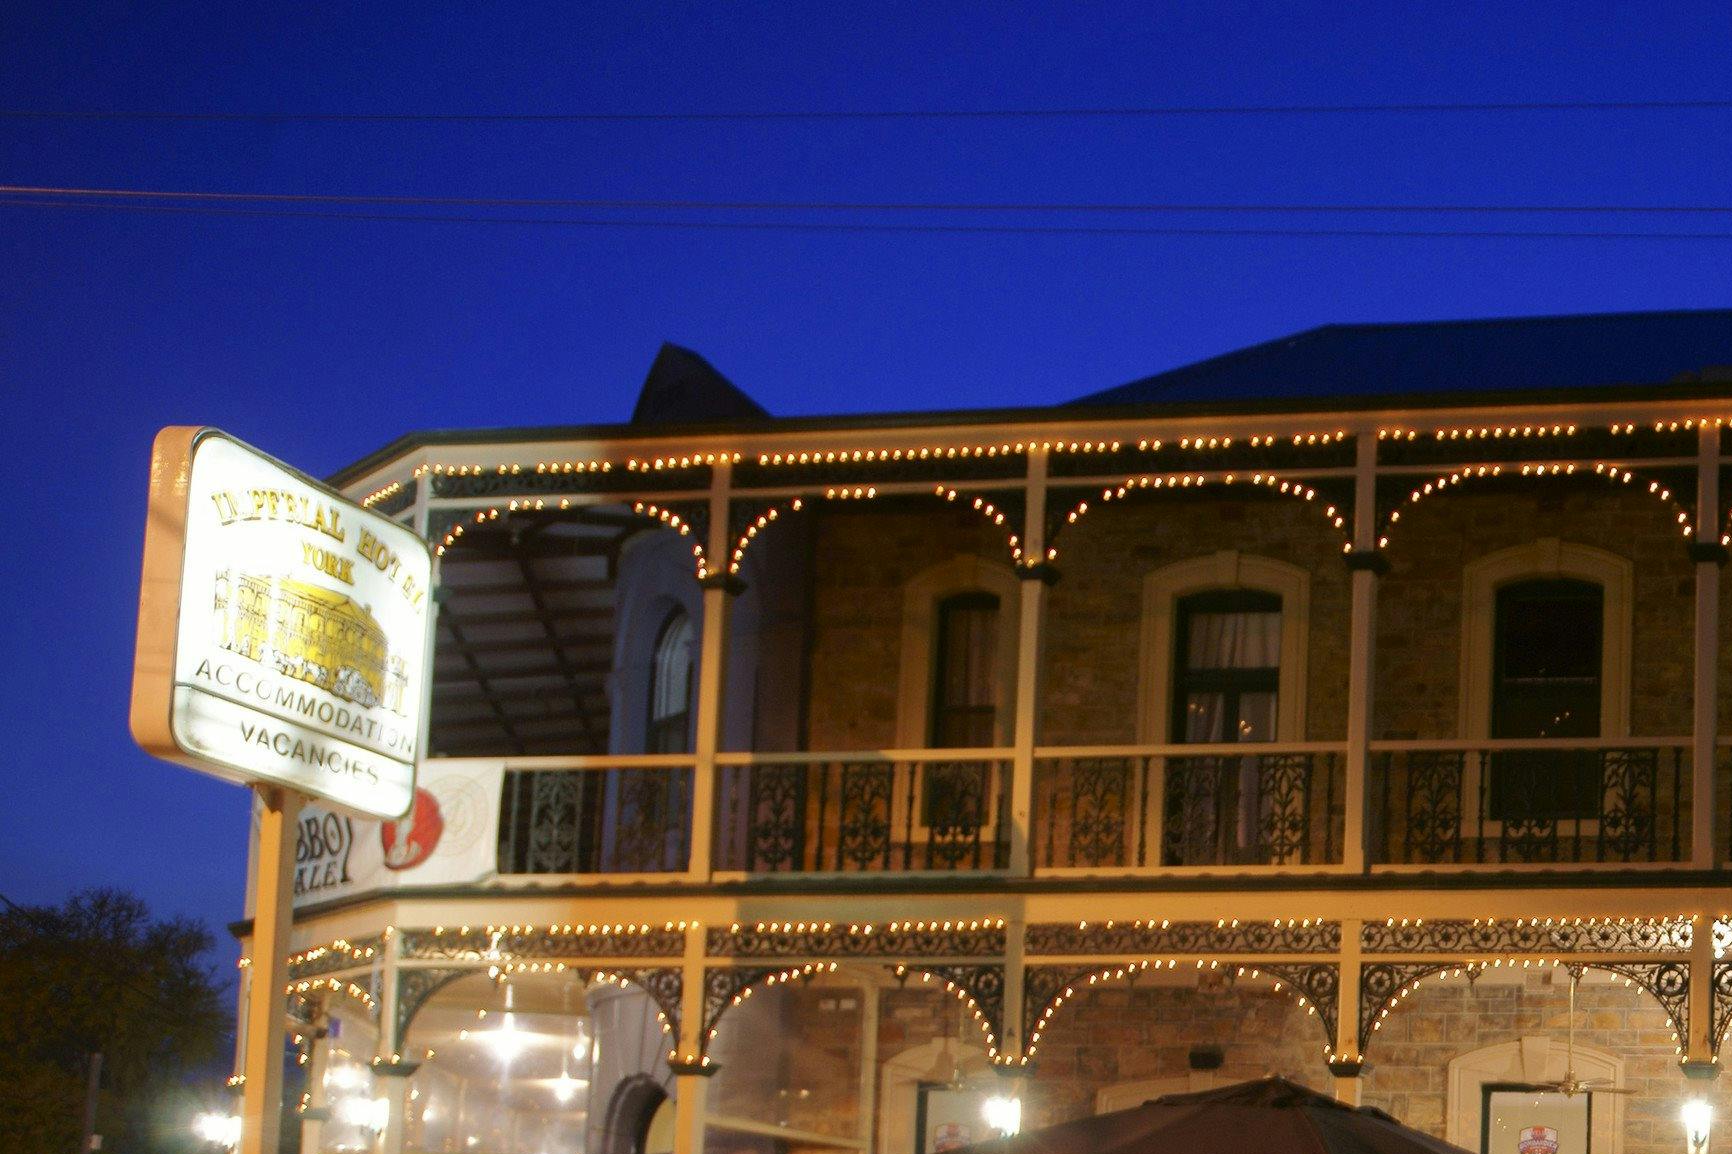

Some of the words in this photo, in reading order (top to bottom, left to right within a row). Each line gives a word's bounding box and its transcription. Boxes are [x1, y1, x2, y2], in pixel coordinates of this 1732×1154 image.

[302, 540, 355, 586] YORK
[195, 658, 412, 753] ACCOMMODATION
[240, 720, 379, 785] VACANCIES
